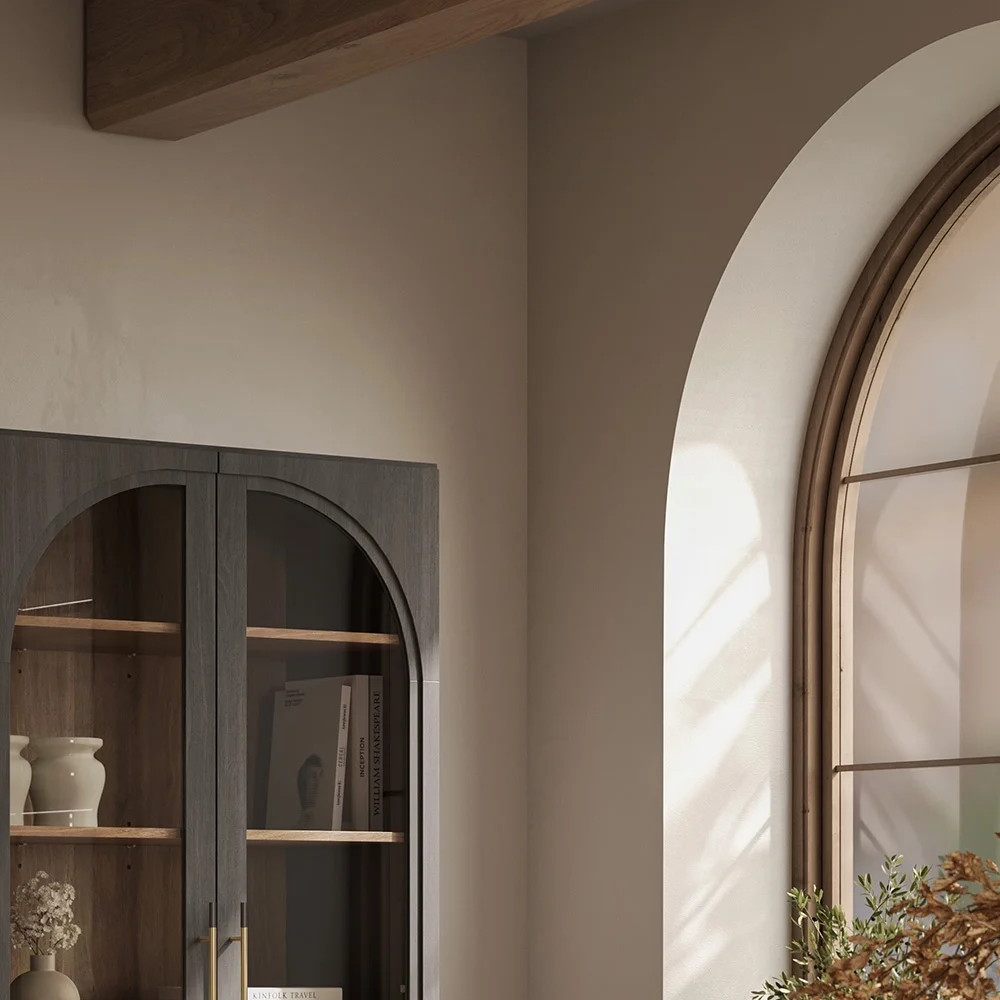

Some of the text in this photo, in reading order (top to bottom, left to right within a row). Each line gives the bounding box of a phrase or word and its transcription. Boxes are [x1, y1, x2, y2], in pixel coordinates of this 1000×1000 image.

[373, 691, 381, 816] WILLIAM SHAKESPEARE
[290, 991, 317, 999] TRAVEL
